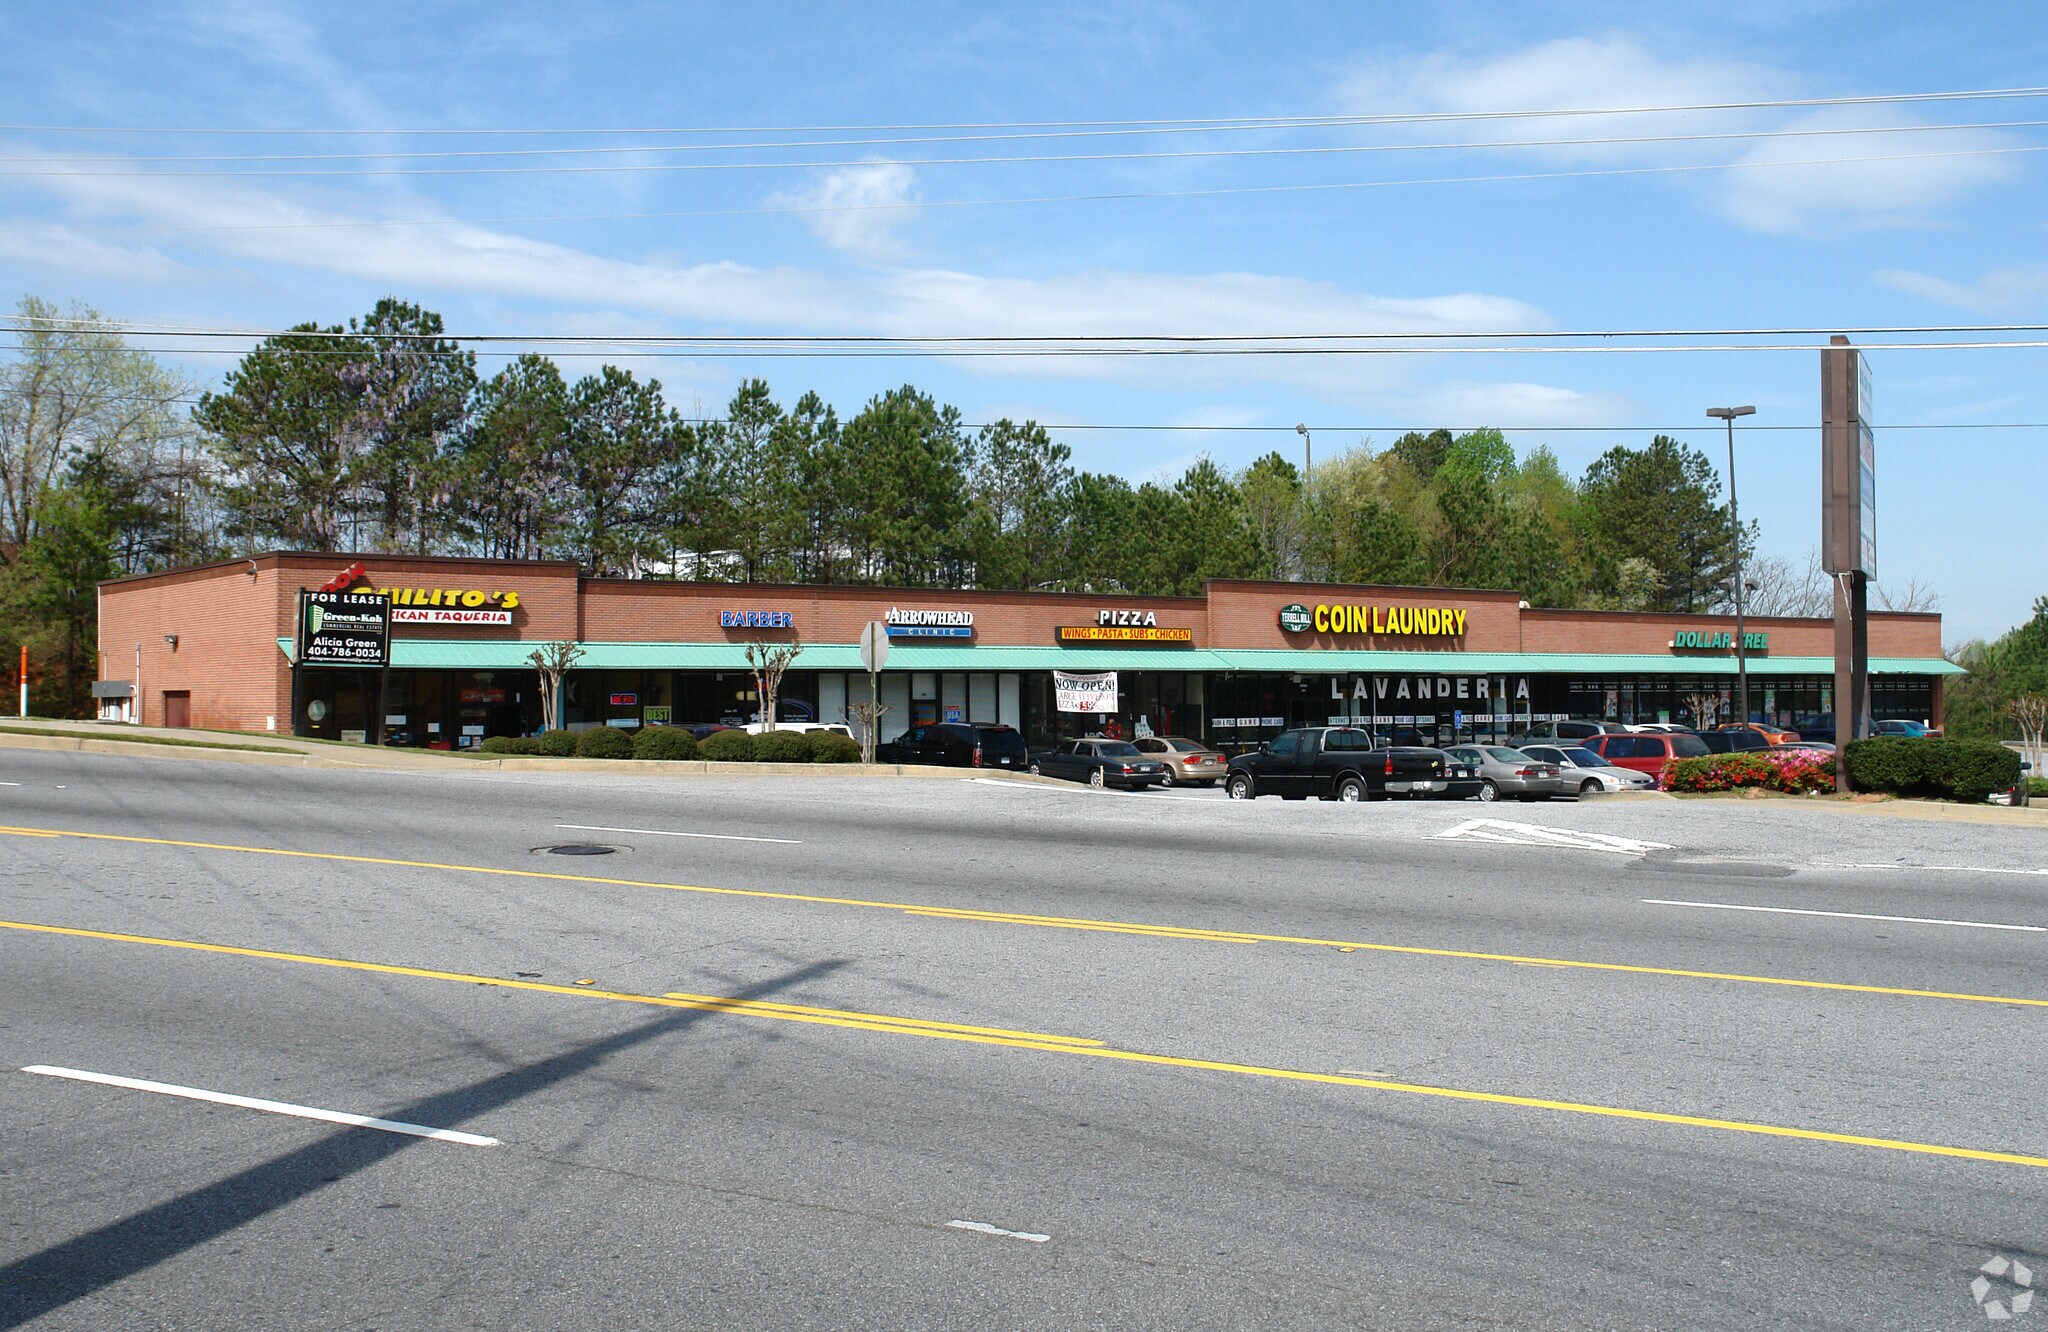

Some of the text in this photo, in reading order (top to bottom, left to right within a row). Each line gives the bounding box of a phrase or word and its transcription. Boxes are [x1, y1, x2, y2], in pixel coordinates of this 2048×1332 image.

[311, 593, 383, 605] FOR LEASE
[323, 612, 383, 623] Green-Koh
[435, 611, 507, 622] TAQUERIA
[721, 611, 794, 628] BARBER
[888, 606, 974, 626] ARROWHEAD
[1099, 610, 1157, 626] PIZZA
[1281, 612, 1300, 623] TERRELL
[1314, 604, 1467, 636] COIN LAUNDRY
[1063, 628, 1189, 639] WINGS PASTA SUBS CHICKEN
[313, 636, 377, 648] Alicia Green
[1675, 631, 1769, 649] DOLLAR REE
[307, 646, 381, 658] 404-786-0034
[1055, 678, 1115, 691] NOW OPEN!
[1331, 677, 1530, 700] LAVANDERIA
[646, 709, 669, 720] BEST
[946, 710, 960, 720] USA
